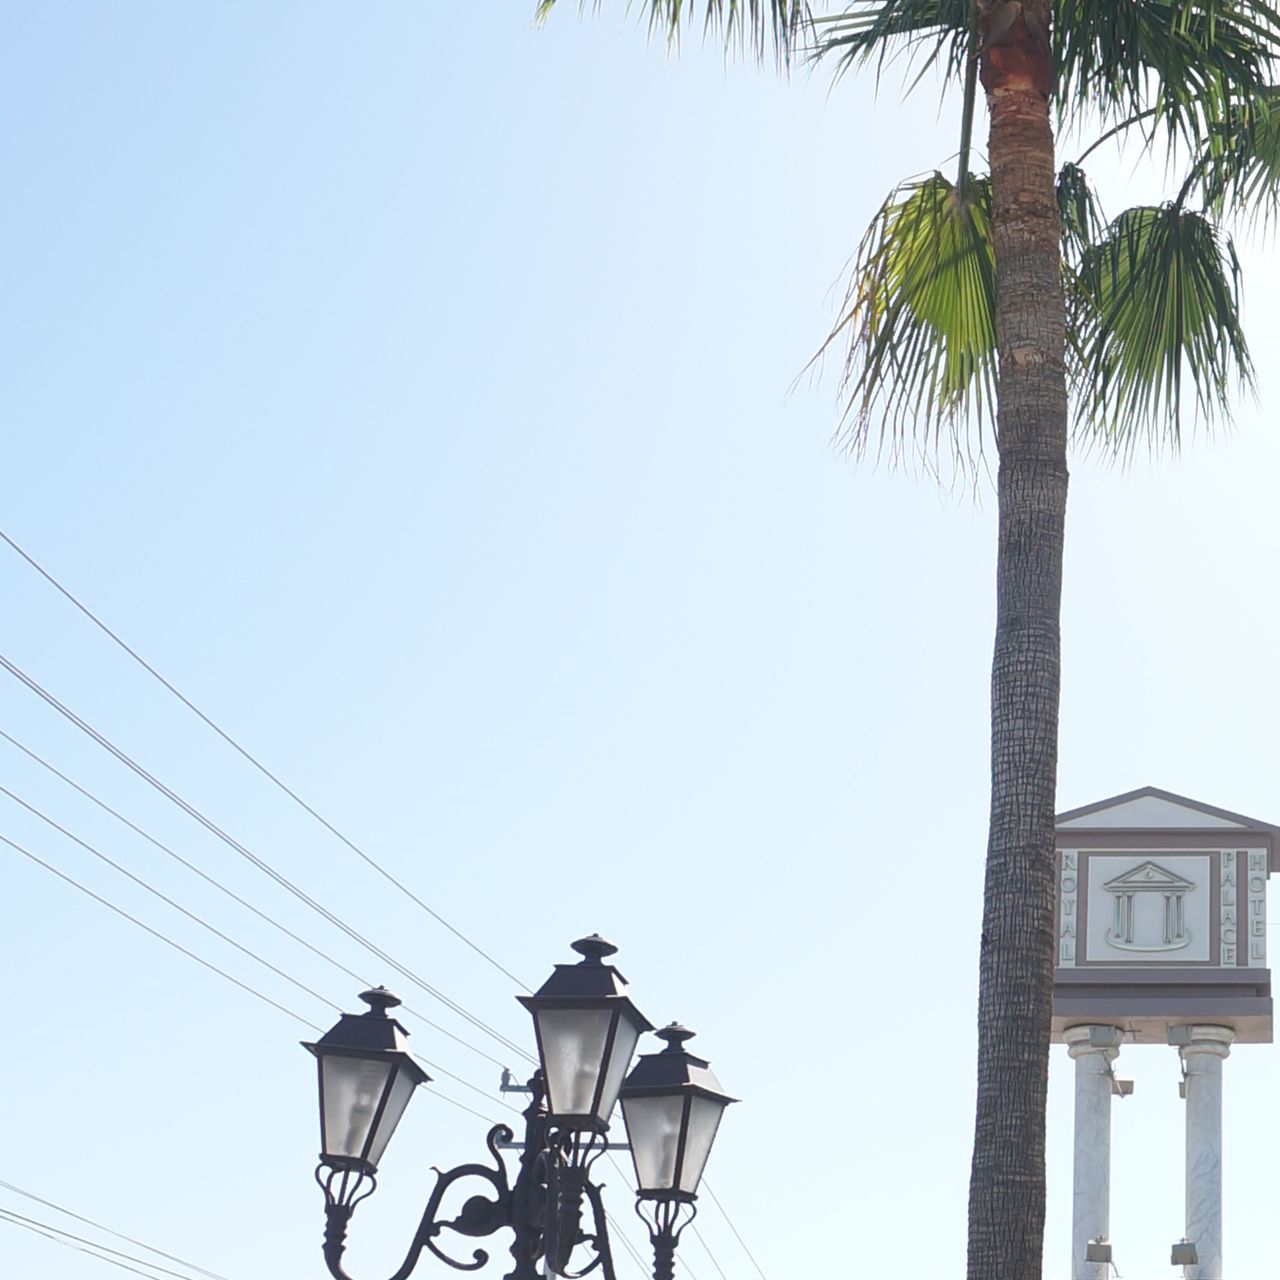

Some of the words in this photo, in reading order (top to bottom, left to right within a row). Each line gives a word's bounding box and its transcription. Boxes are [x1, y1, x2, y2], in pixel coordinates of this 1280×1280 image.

[1060, 853, 1078, 962] ROYAL
[1220, 851, 1238, 966] PALACE
[1249, 854, 1266, 961] HOTEL
